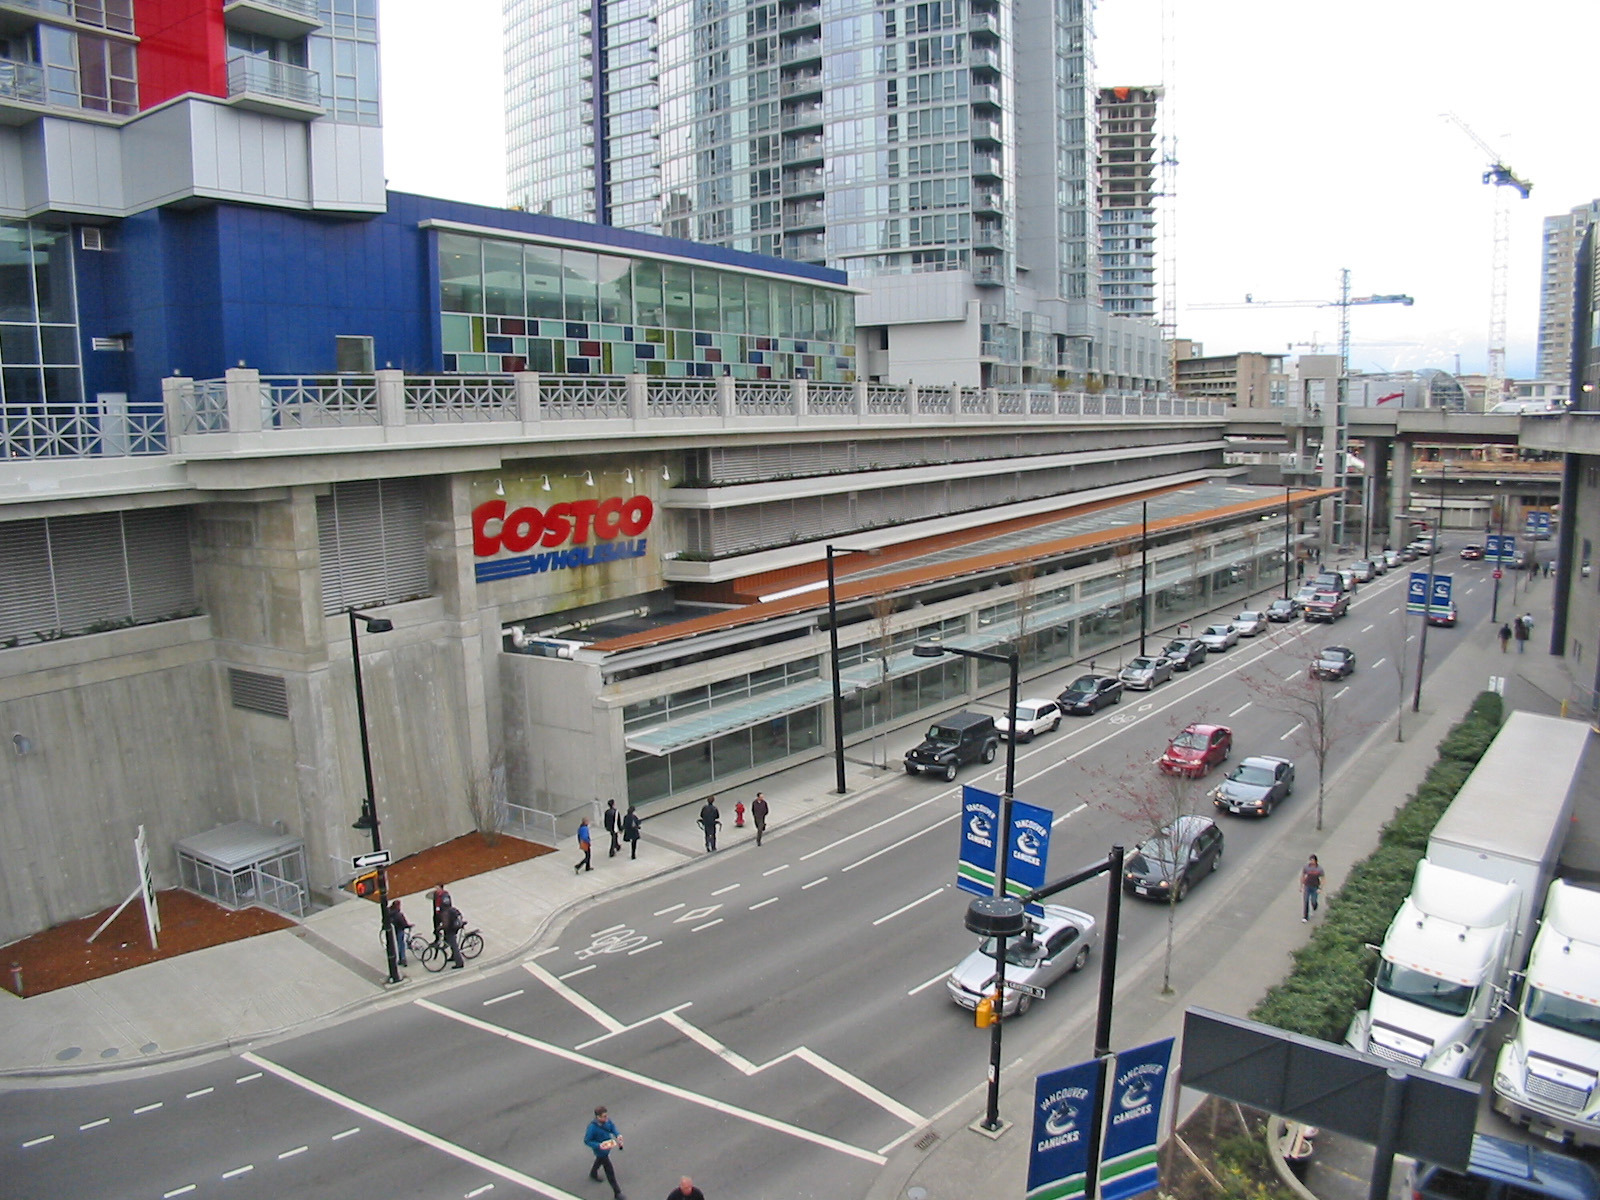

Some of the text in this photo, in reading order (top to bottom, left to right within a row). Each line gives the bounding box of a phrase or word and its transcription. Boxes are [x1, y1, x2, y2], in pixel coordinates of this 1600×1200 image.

[472, 495, 653, 557] COSTCO
[530, 539, 647, 574] WHOLESALE
[1117, 1063, 1163, 1086] VANCOUVER
[1040, 1086, 1088, 1111] VANCOUVER
[1113, 1104, 1152, 1125] CANUCKS
[1038, 1130, 1080, 1152] CANUCKS
